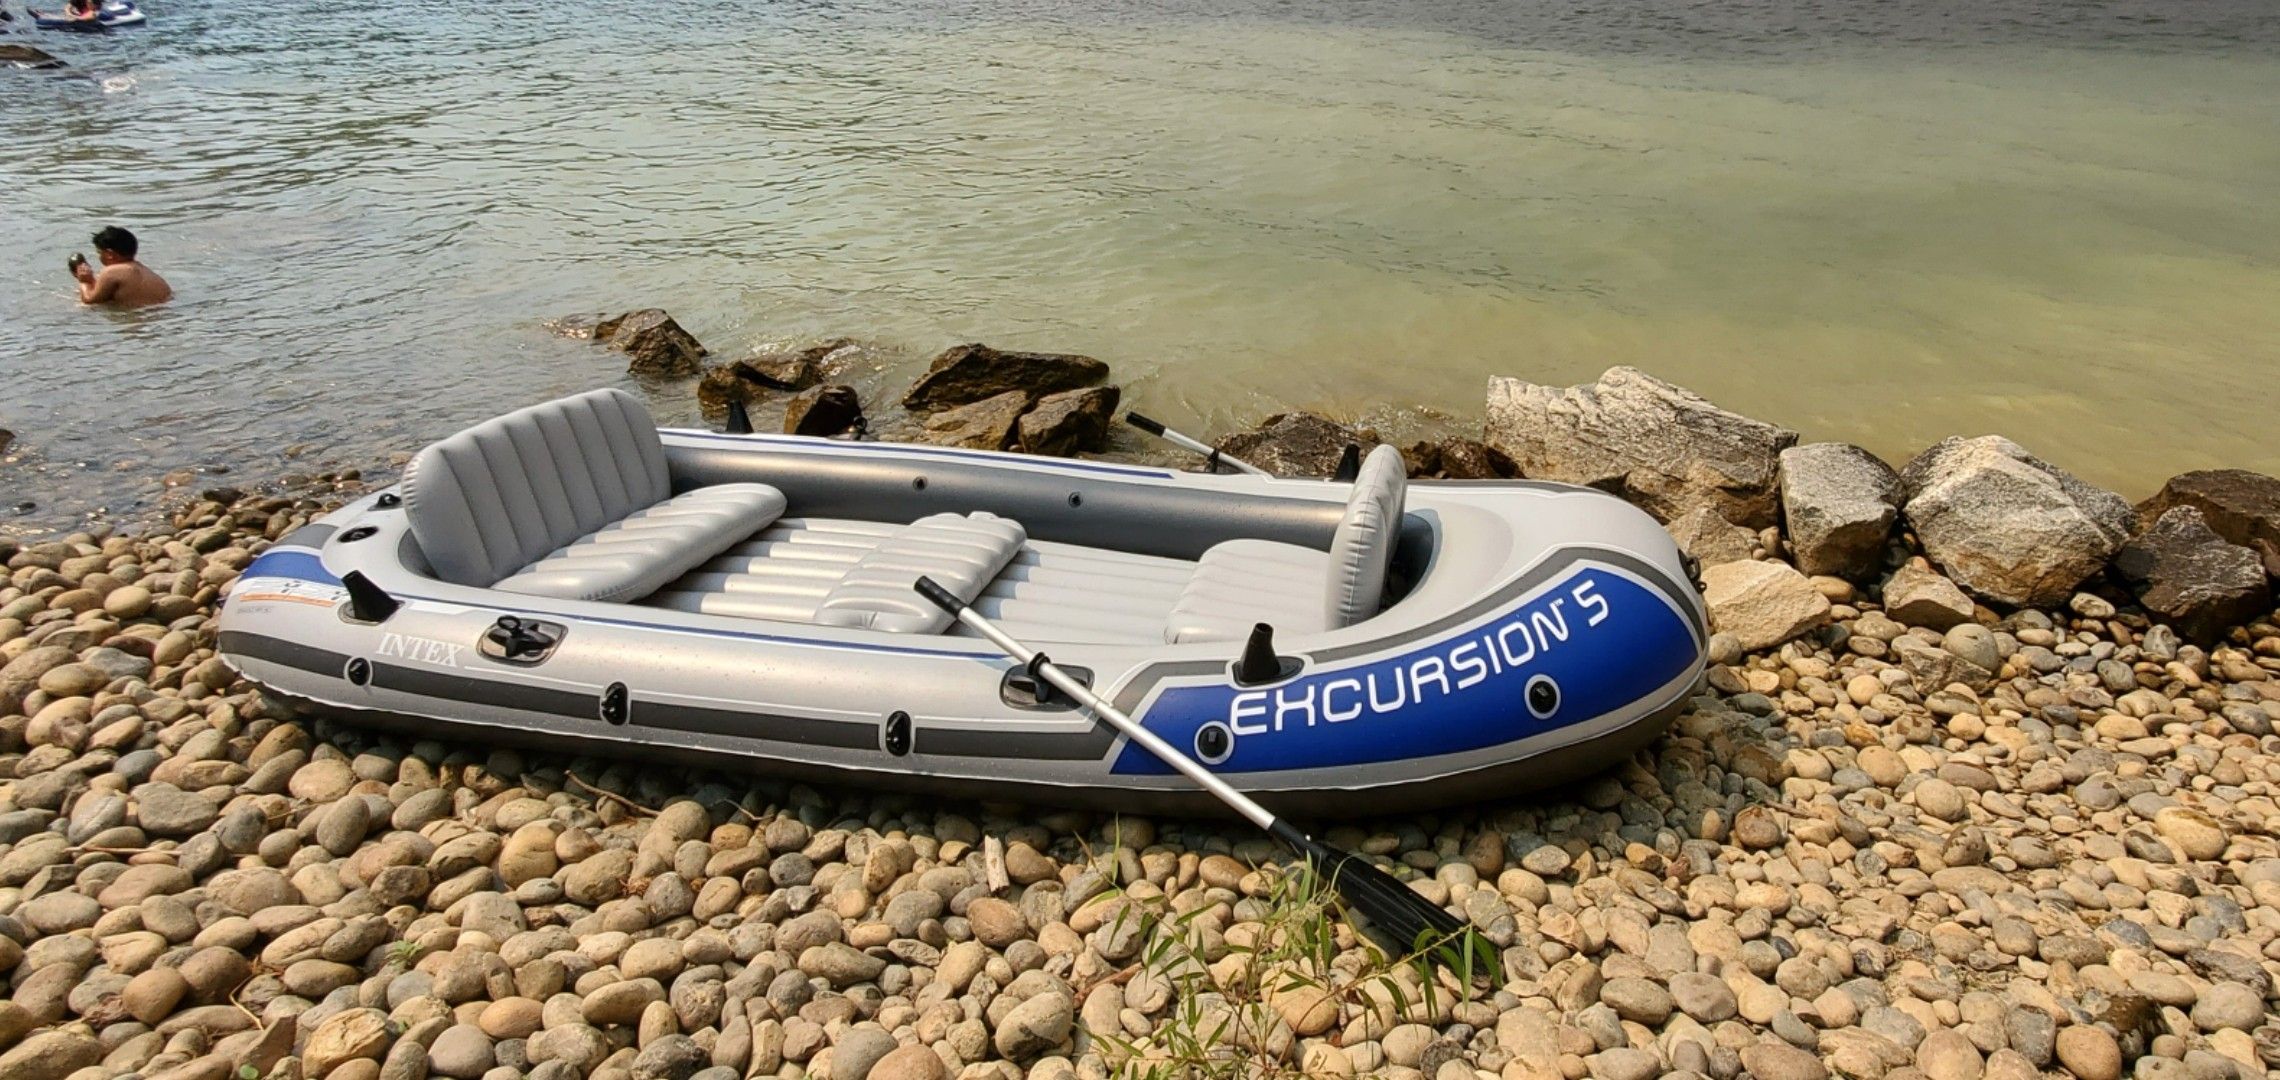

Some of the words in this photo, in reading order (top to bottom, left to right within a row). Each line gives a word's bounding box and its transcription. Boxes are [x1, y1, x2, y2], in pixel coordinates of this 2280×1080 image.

[376, 632, 464, 667] INTEX
[1230, 599, 1569, 735] EXCURSION
[1571, 579, 1609, 627] 5
